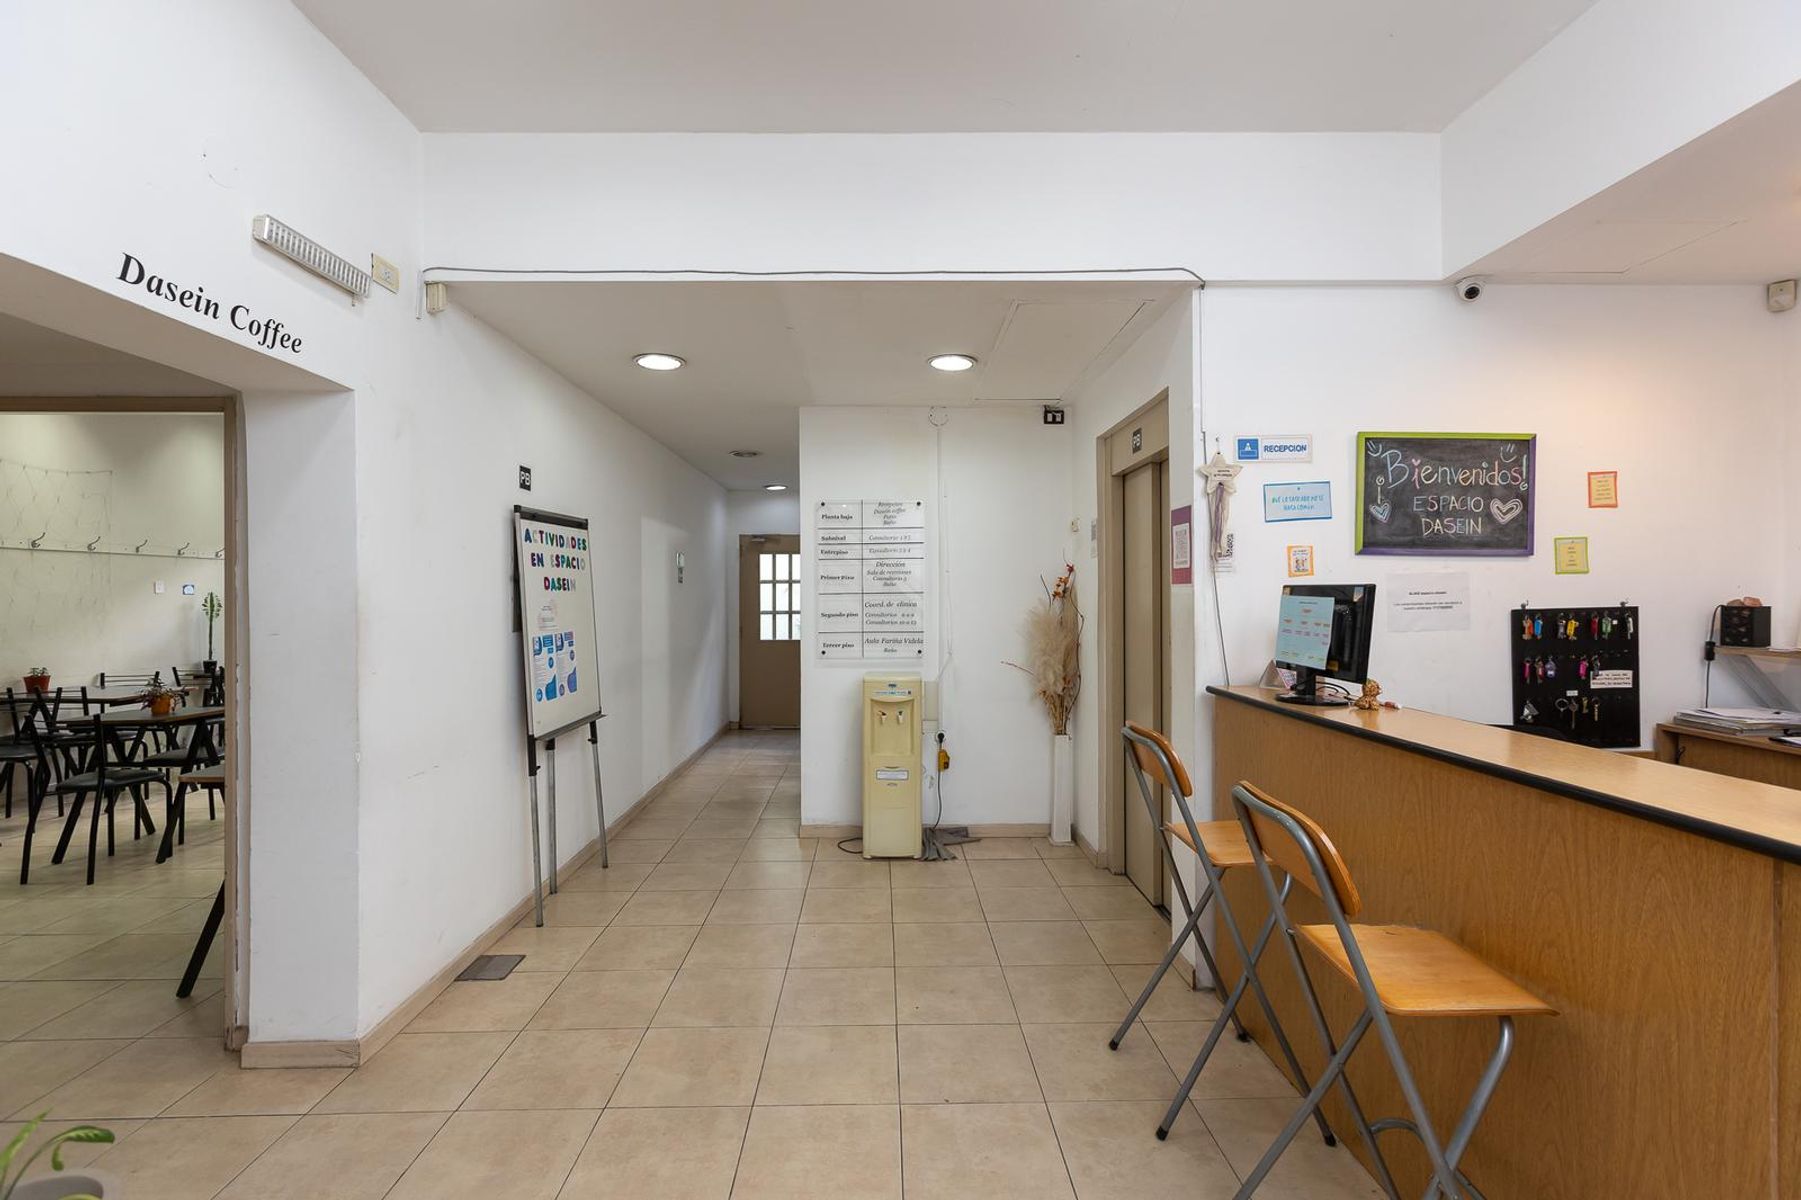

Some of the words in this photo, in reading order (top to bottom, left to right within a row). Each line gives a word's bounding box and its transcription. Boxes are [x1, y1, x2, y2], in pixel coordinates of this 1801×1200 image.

[116, 252, 220, 320] Dasein
[230, 304, 303, 354] Coffee
[1263, 444, 1307, 453] RECEPCION
[520, 471, 531, 486] PB
[1412, 495, 1484, 512] ESPACIO
[821, 512, 840, 520] Planta
[840, 512, 853, 520] baja
[1420, 517, 1482, 537] DASEIN
[524, 527, 587, 552] ACTIVIDADES
[530, 552, 544, 567] EN
[550, 553, 586, 571] ESPACIO
[543, 576, 576, 591] DASEIN
[841, 641, 855, 649] piso
